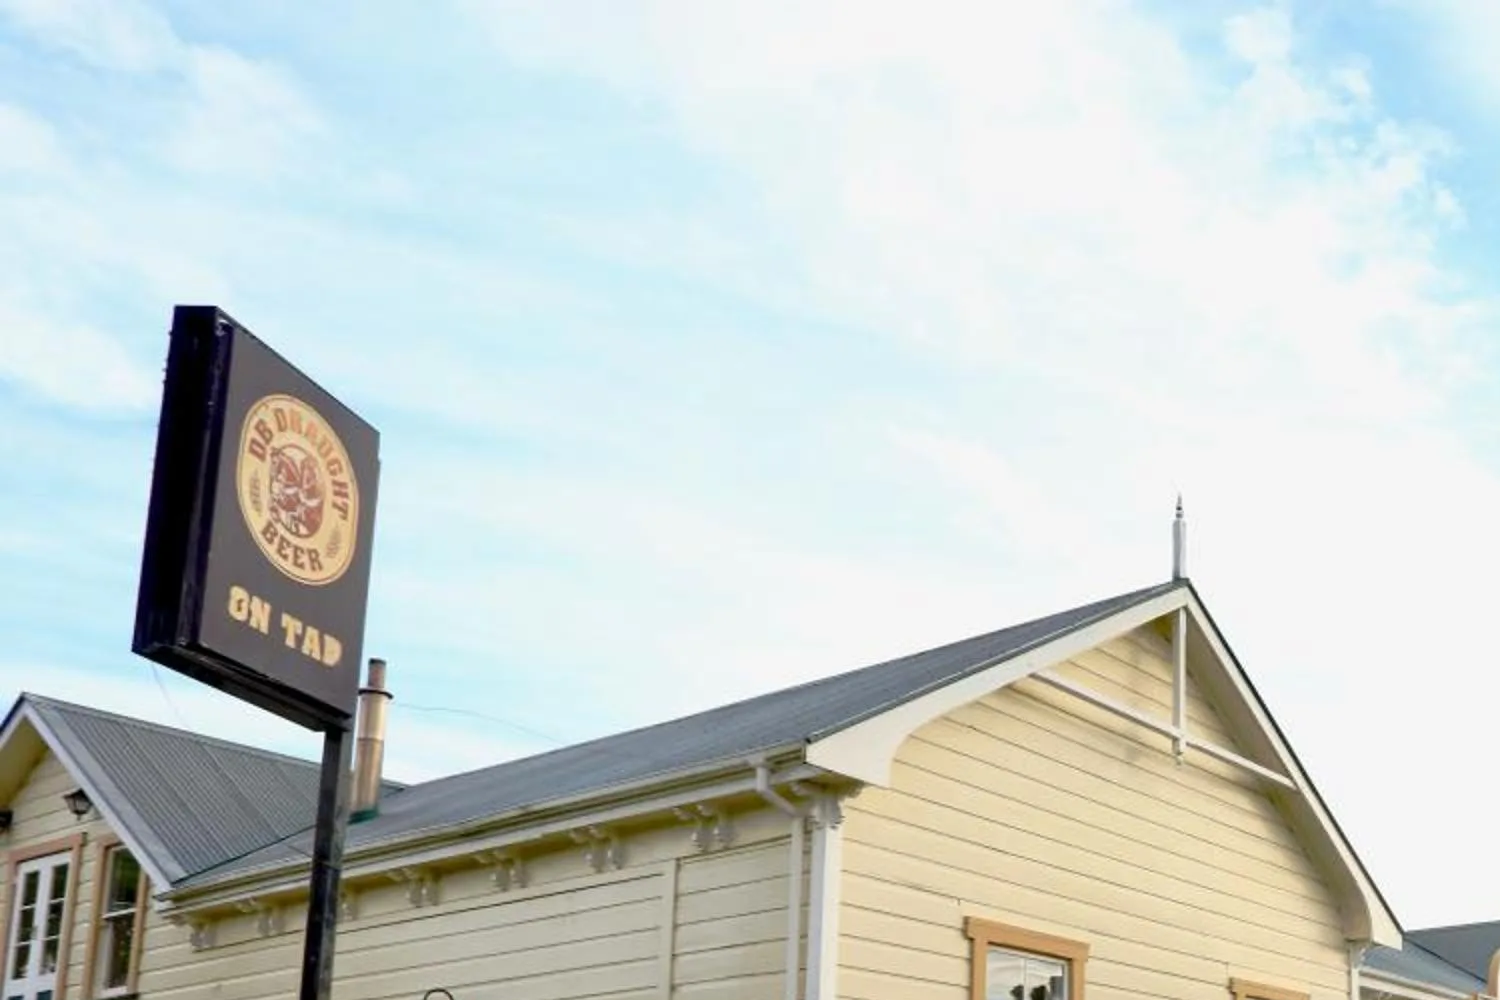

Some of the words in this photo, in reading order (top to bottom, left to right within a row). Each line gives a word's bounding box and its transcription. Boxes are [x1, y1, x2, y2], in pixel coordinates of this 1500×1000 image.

[249, 418, 273, 462] DB
[274, 407, 349, 520] DRAUGHT
[261, 521, 323, 571] BEER
[228, 585, 272, 635] ON
